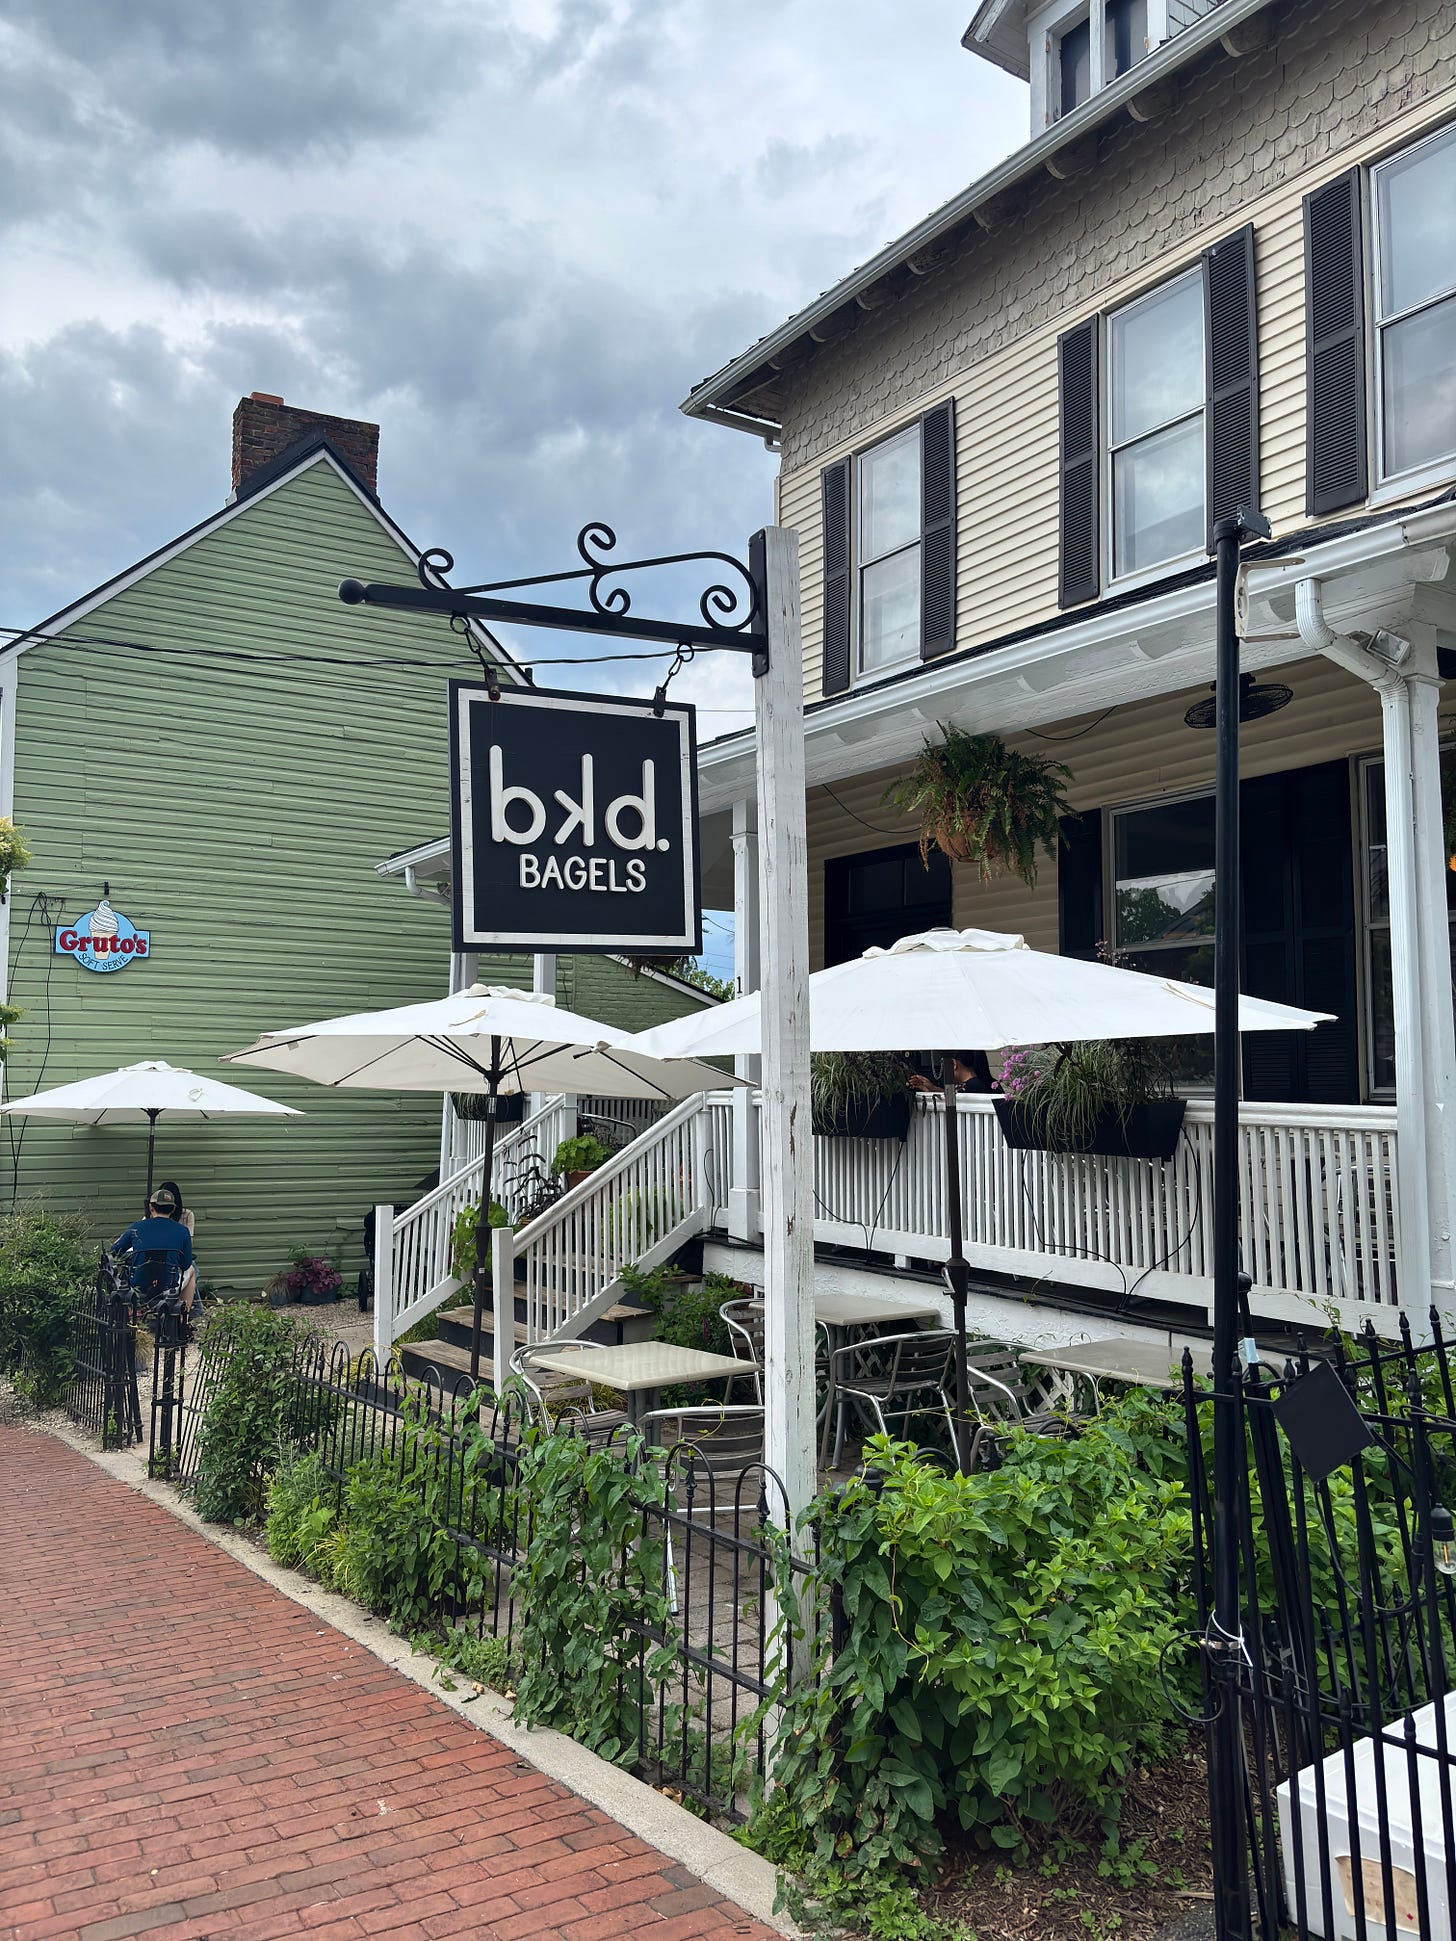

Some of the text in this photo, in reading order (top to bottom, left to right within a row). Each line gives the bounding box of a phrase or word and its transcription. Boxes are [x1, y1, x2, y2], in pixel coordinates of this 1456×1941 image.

[519, 853, 647, 892] BAGELS
[59, 929, 147, 955] Gruto's
[78, 953, 129, 971] SOFT SERVE
